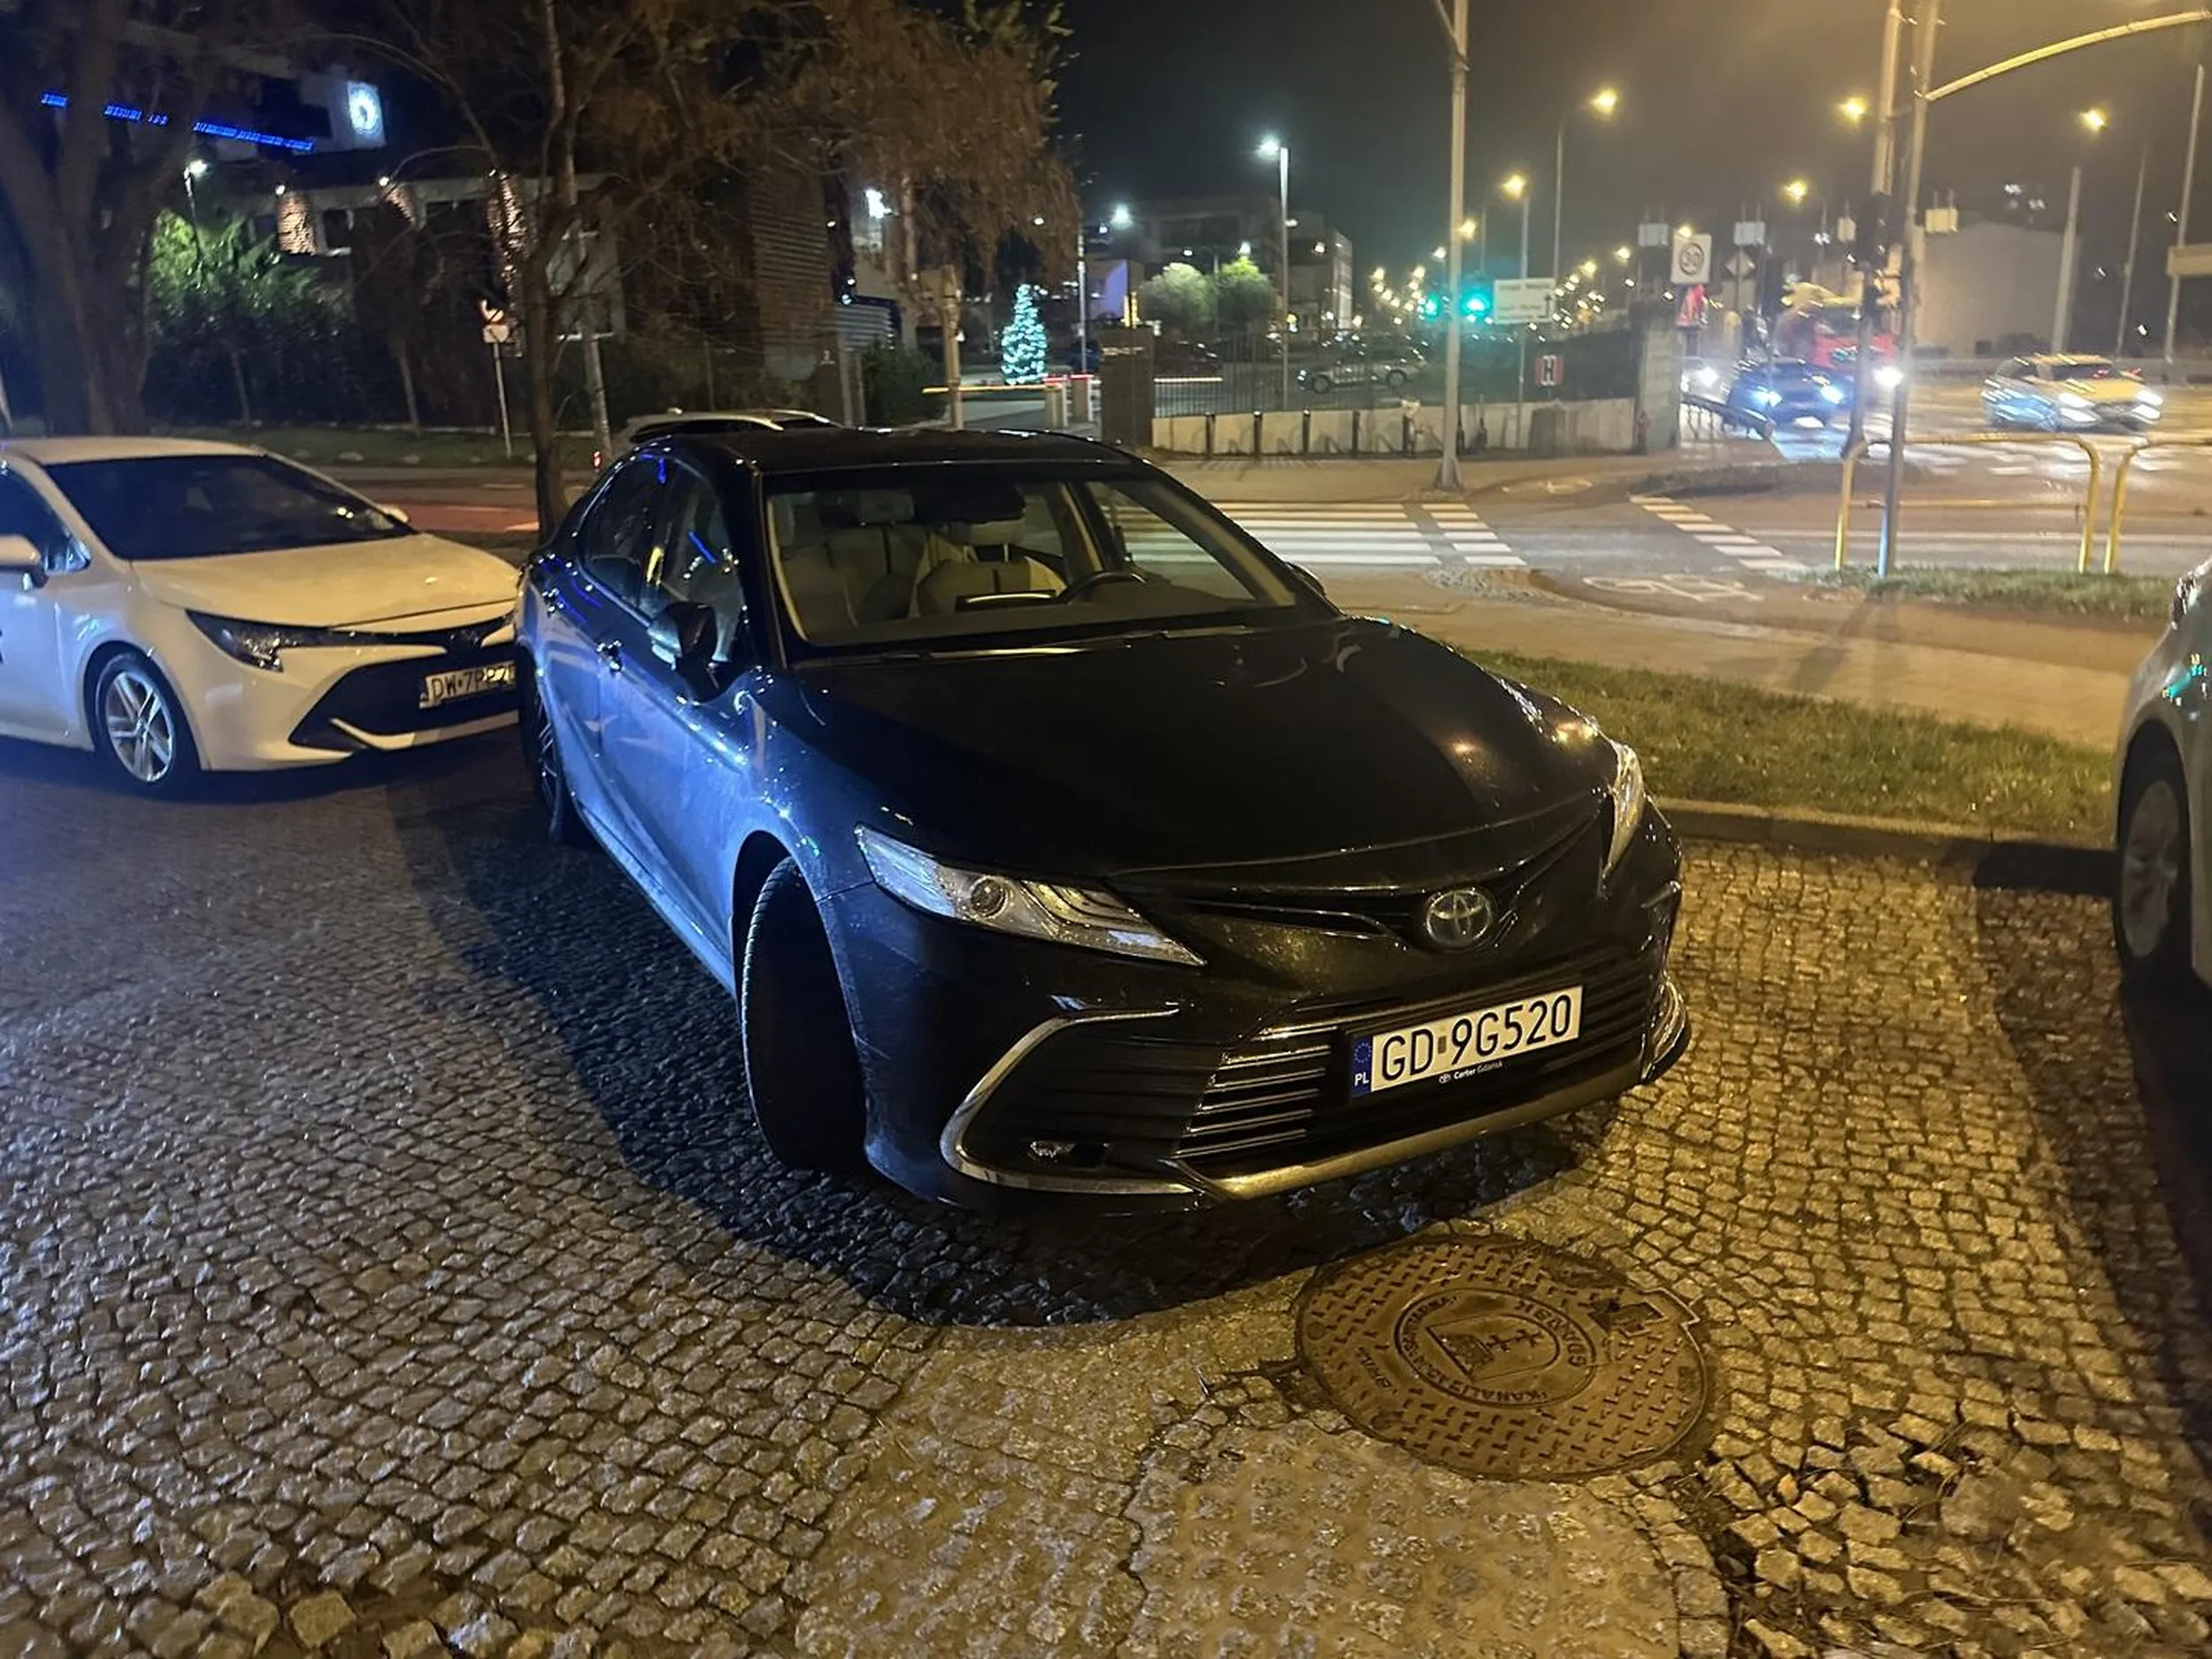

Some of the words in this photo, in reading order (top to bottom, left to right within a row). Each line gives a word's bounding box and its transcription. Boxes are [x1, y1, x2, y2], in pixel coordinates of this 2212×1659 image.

[1381, 1028, 1434, 1081] GD
[1451, 995, 1571, 1066] 9G520
[1354, 1072, 1370, 1087] PL
[1454, 1068, 1476, 1079] Carter
